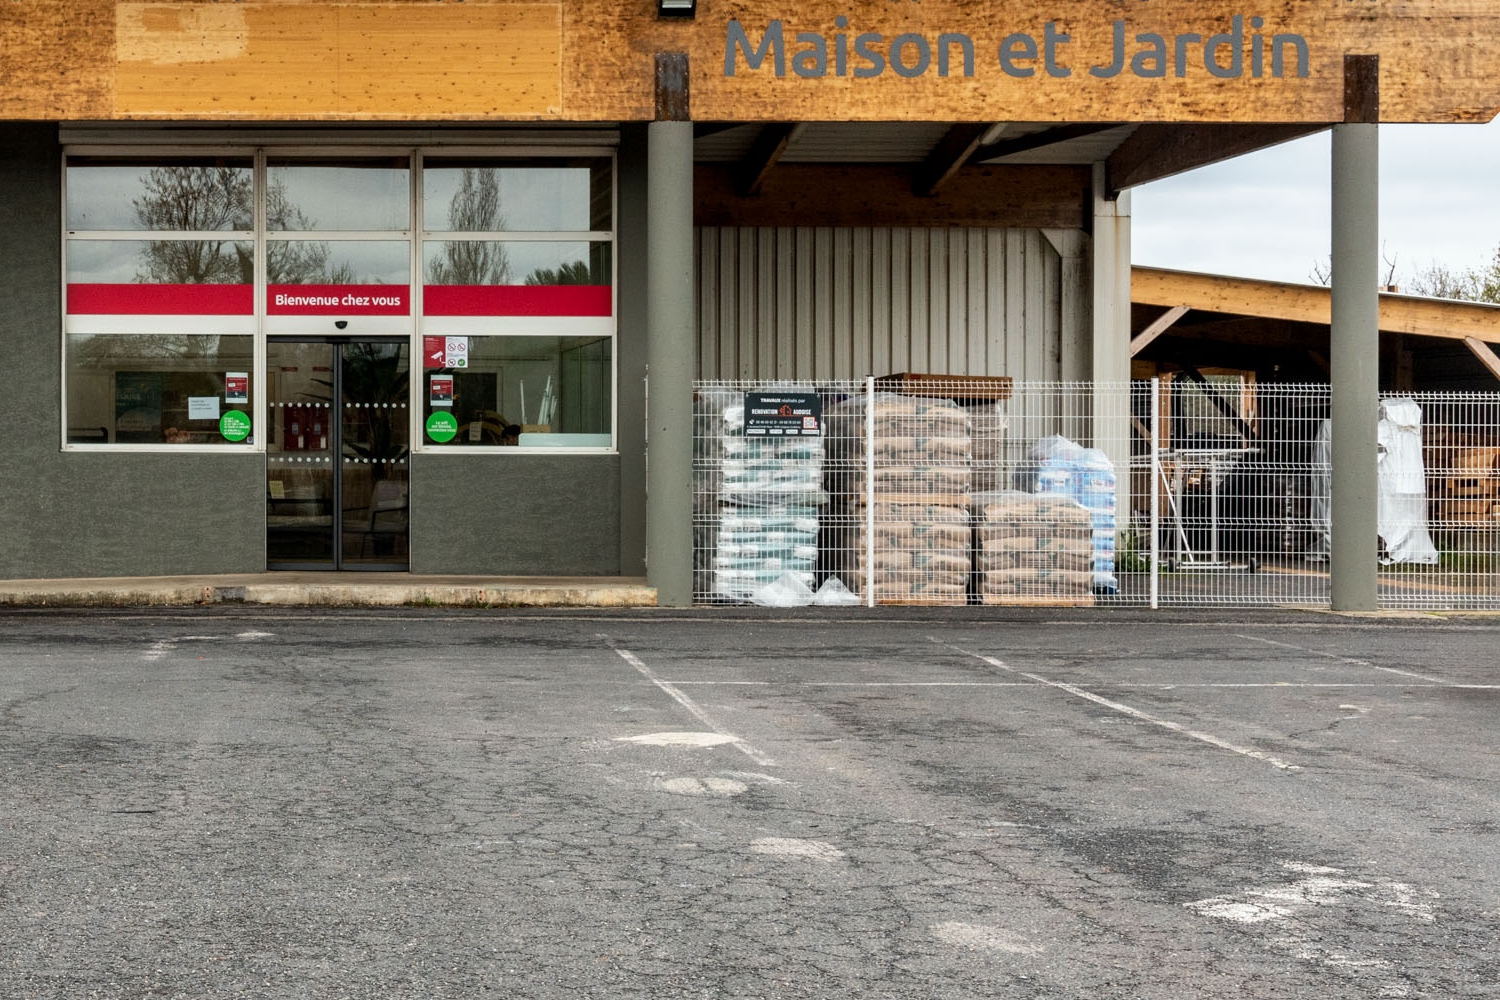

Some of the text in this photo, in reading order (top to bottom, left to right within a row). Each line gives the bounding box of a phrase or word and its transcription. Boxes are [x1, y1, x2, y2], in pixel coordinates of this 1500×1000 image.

[725, 16, 1308, 77] Maison et Jardin
[276, 294, 400, 305] Bienvenue chez vous
